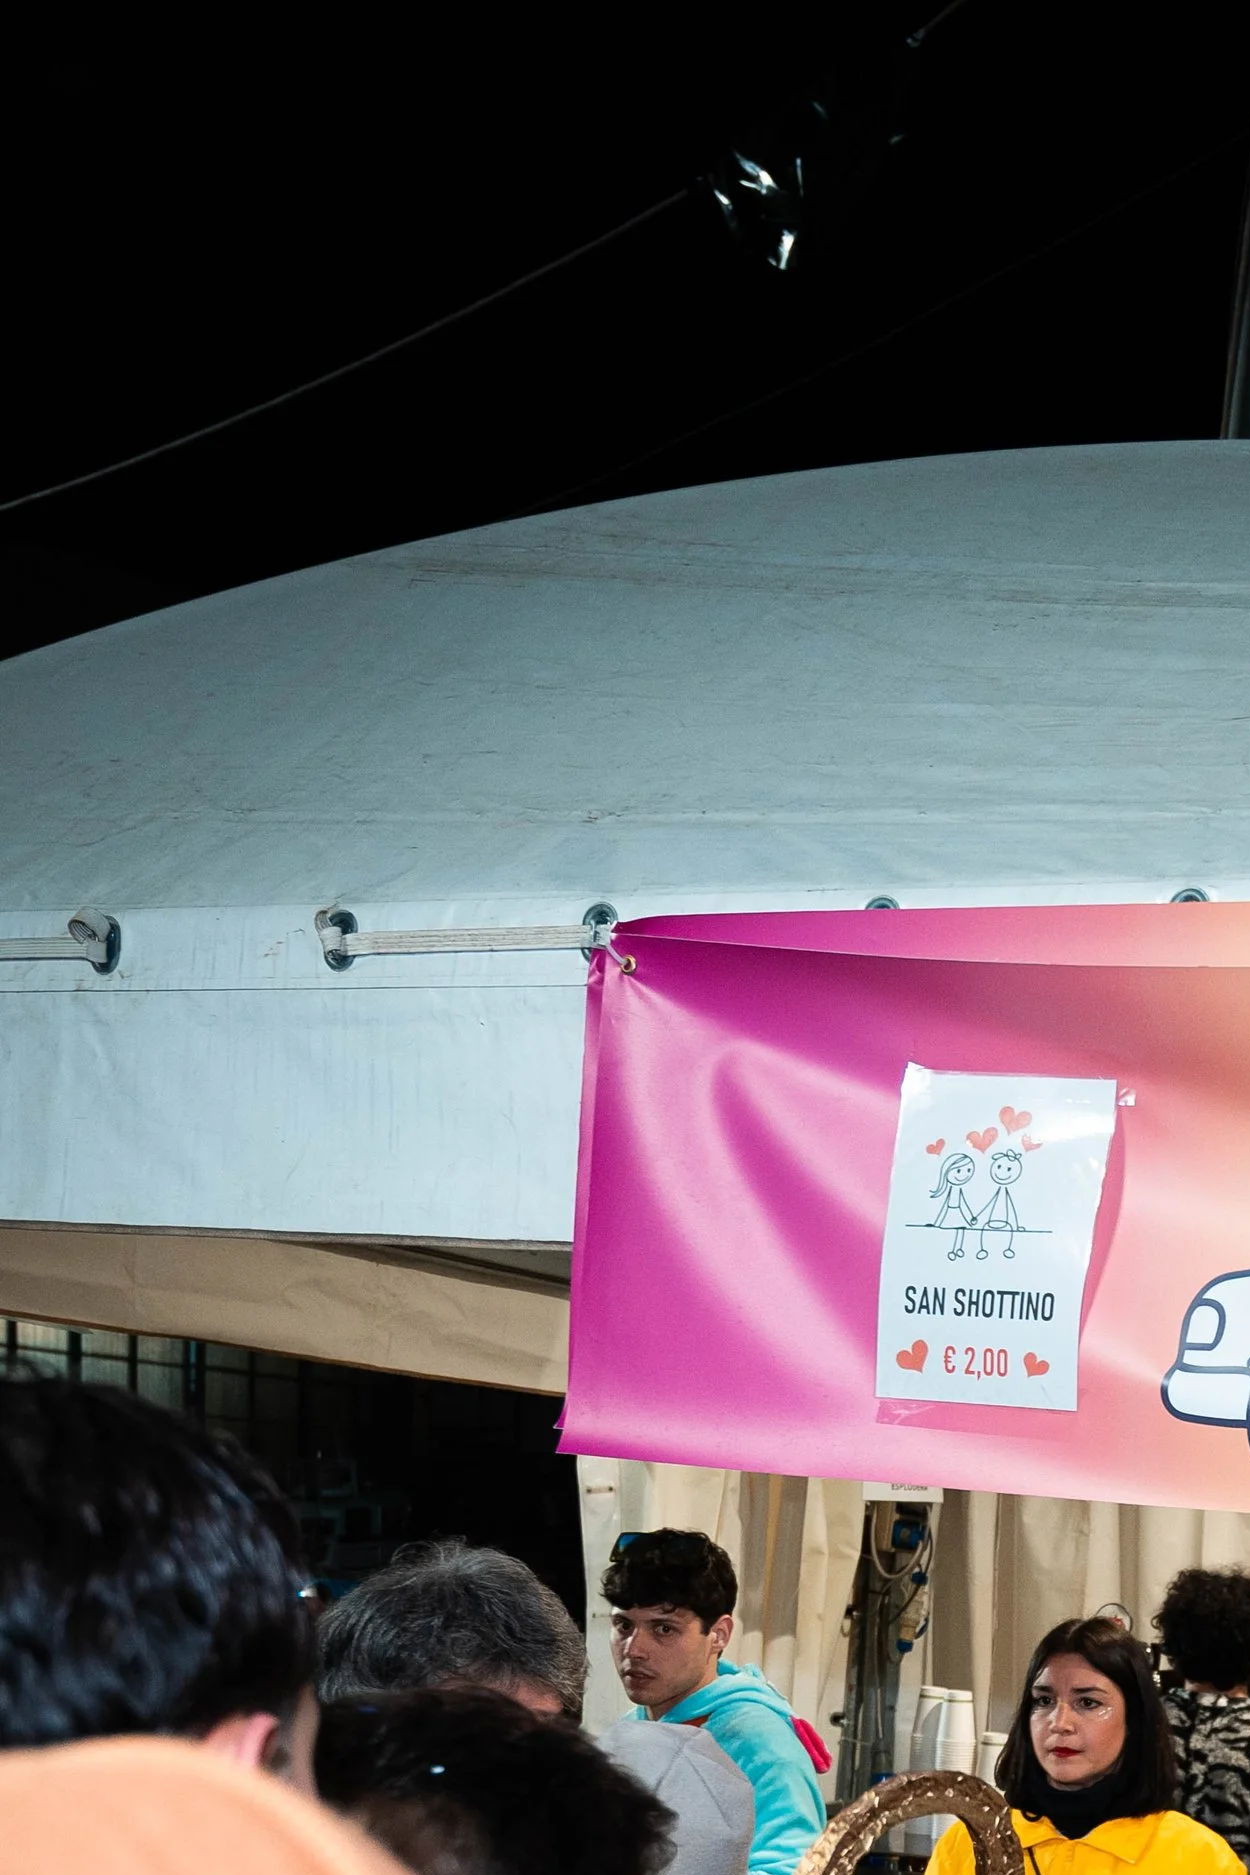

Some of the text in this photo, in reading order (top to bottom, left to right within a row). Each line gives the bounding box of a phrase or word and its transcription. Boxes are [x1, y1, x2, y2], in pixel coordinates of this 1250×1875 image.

[904, 1286, 1055, 1322] SAN SHOTTINO
[943, 1345, 1008, 1381] € 2,00
